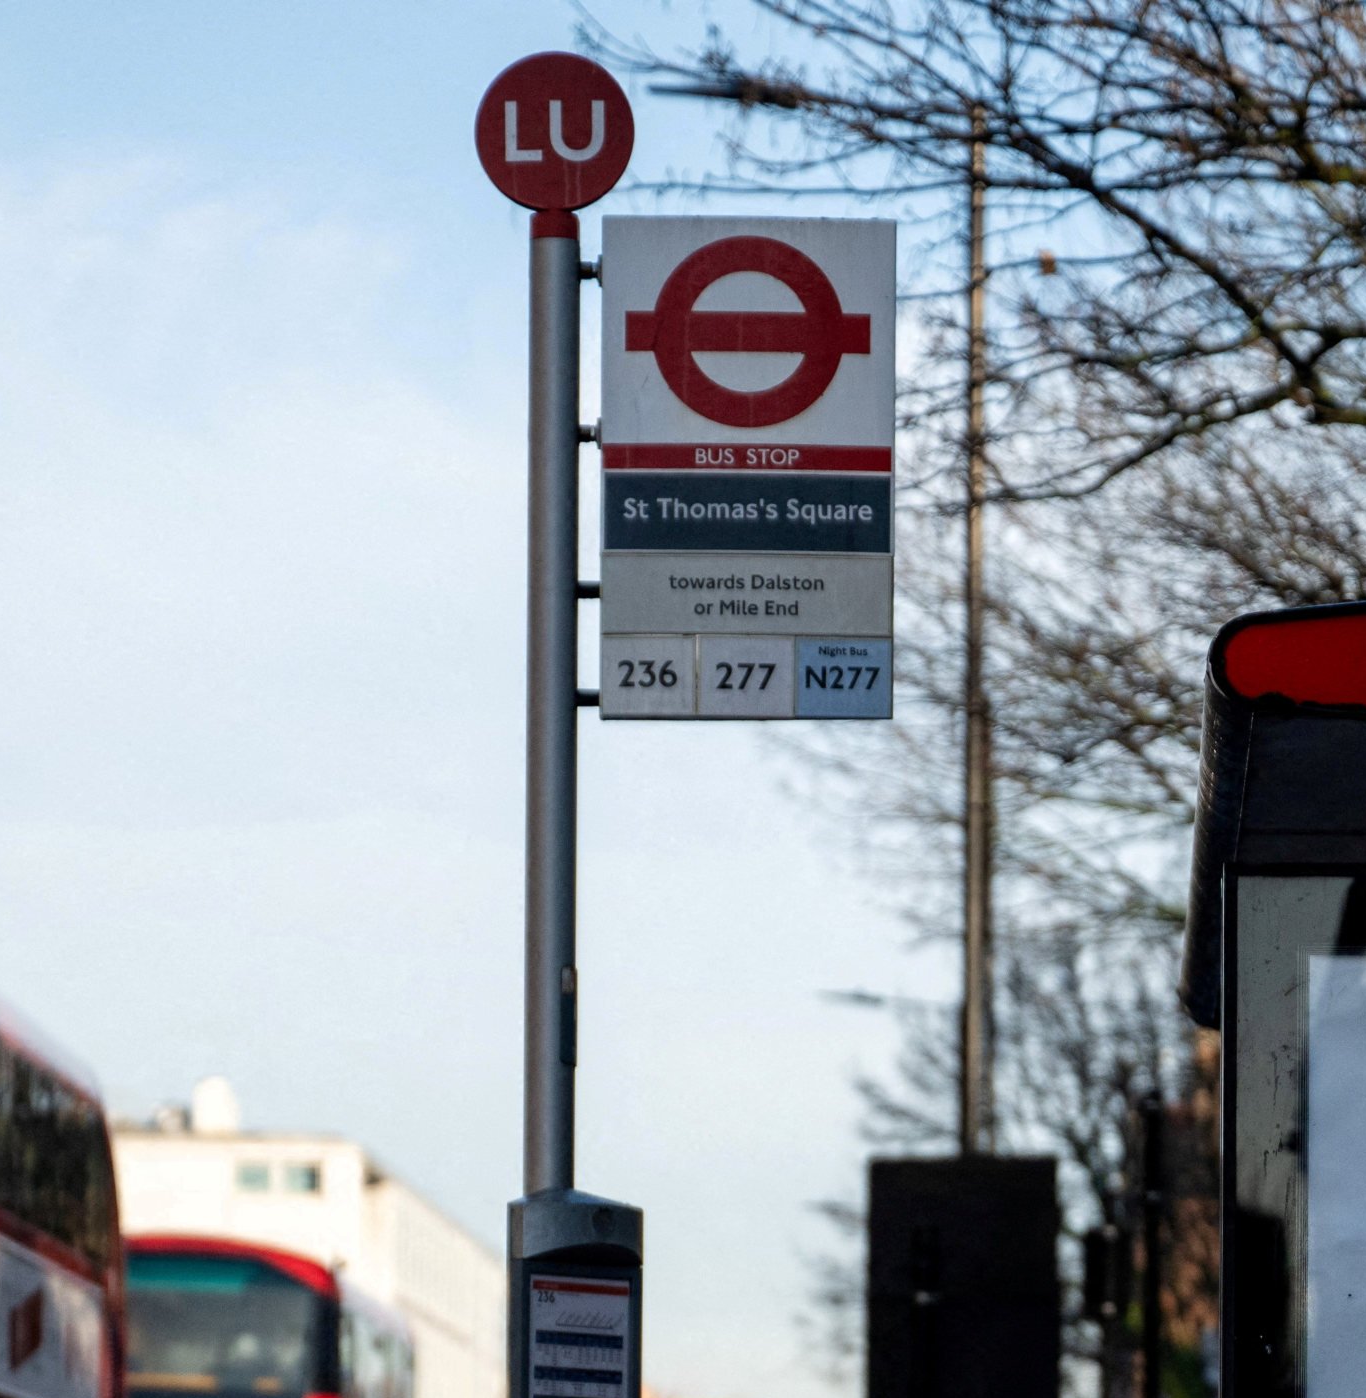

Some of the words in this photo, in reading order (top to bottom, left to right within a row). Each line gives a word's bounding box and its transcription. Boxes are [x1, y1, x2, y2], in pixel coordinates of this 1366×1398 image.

[505, 100, 604, 162] LU
[695, 448, 735, 464] BUS
[746, 449, 800, 465] STOP
[623, 498, 649, 520] St
[656, 498, 778, 520] Thomas's
[786, 499, 873, 524] Square
[669, 574, 745, 589] towards
[751, 575, 825, 590] Dalston
[694, 603, 713, 615] or
[720, 601, 758, 616] Mile
[765, 601, 799, 616] End
[819, 646, 847, 657] Night
[850, 647, 868, 656] Bus
[618, 660, 677, 688] 236
[715, 663, 776, 690] 277
[805, 666, 880, 690] N277
[537, 1291, 555, 1303] 236
